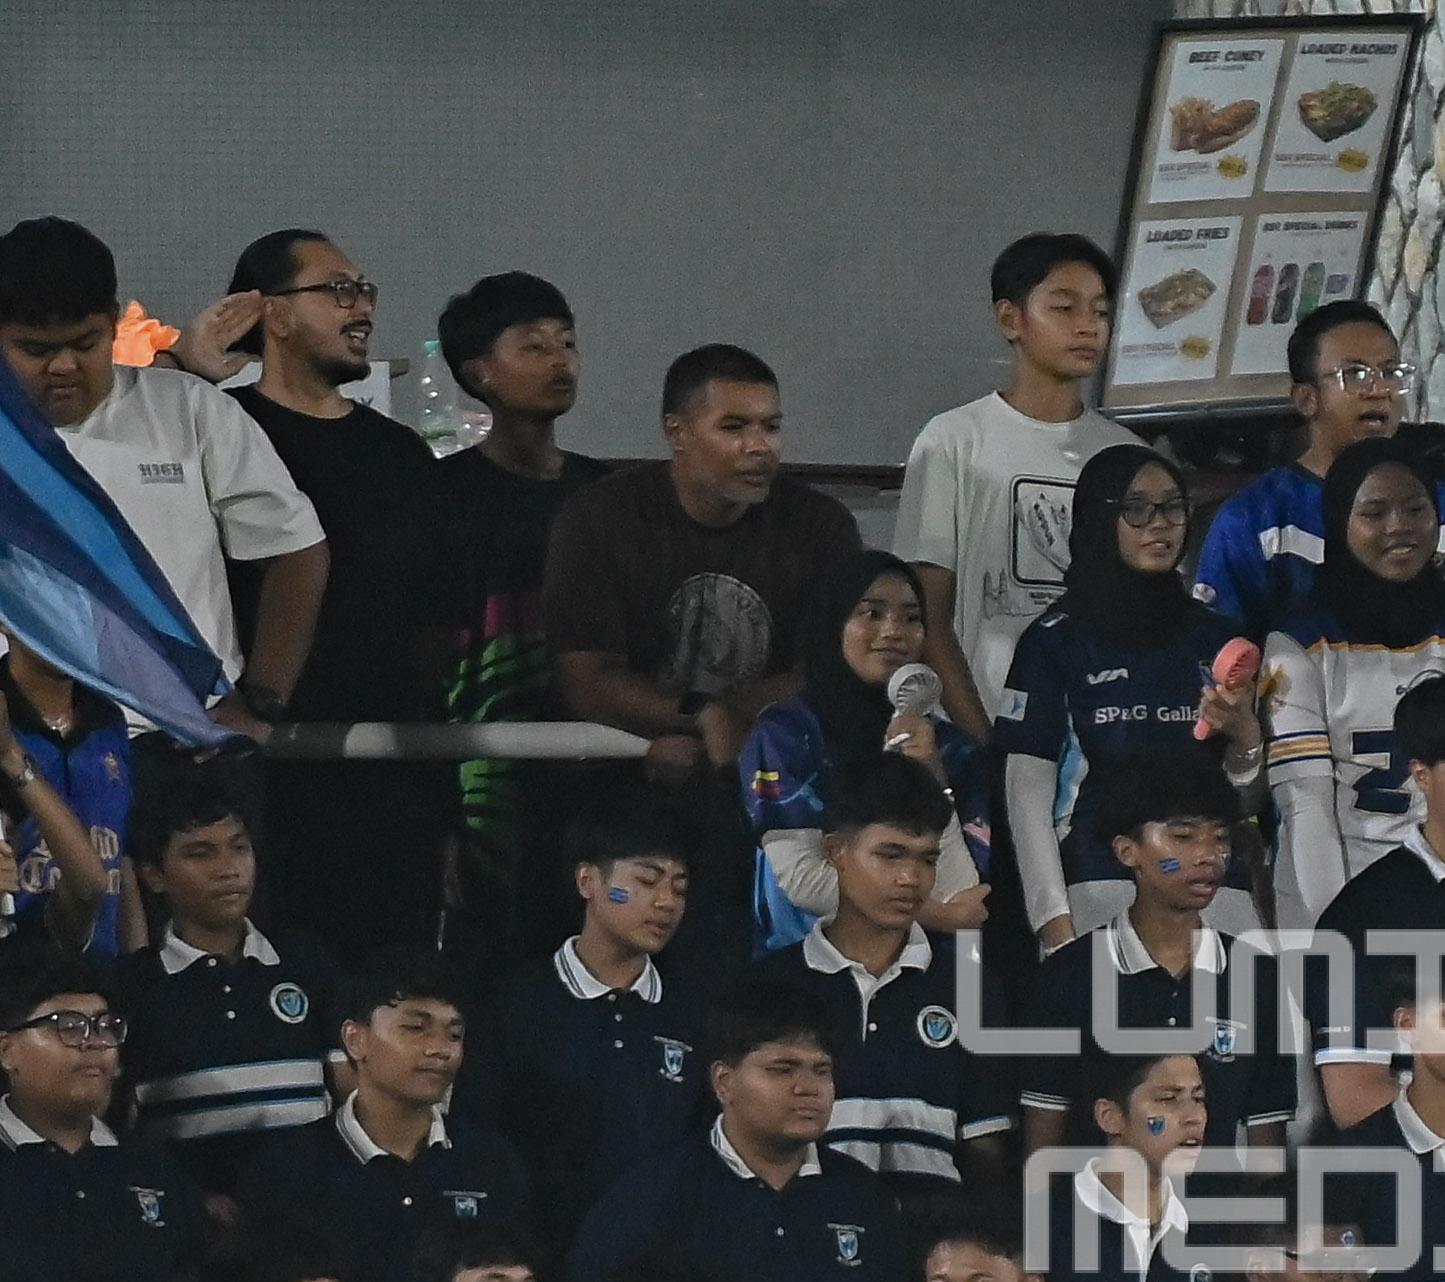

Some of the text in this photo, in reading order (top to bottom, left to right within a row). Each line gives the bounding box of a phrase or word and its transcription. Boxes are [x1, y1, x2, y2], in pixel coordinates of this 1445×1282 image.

[1146, 229, 1194, 243] LOADED
[1095, 705, 1201, 724] SP&G Galla
